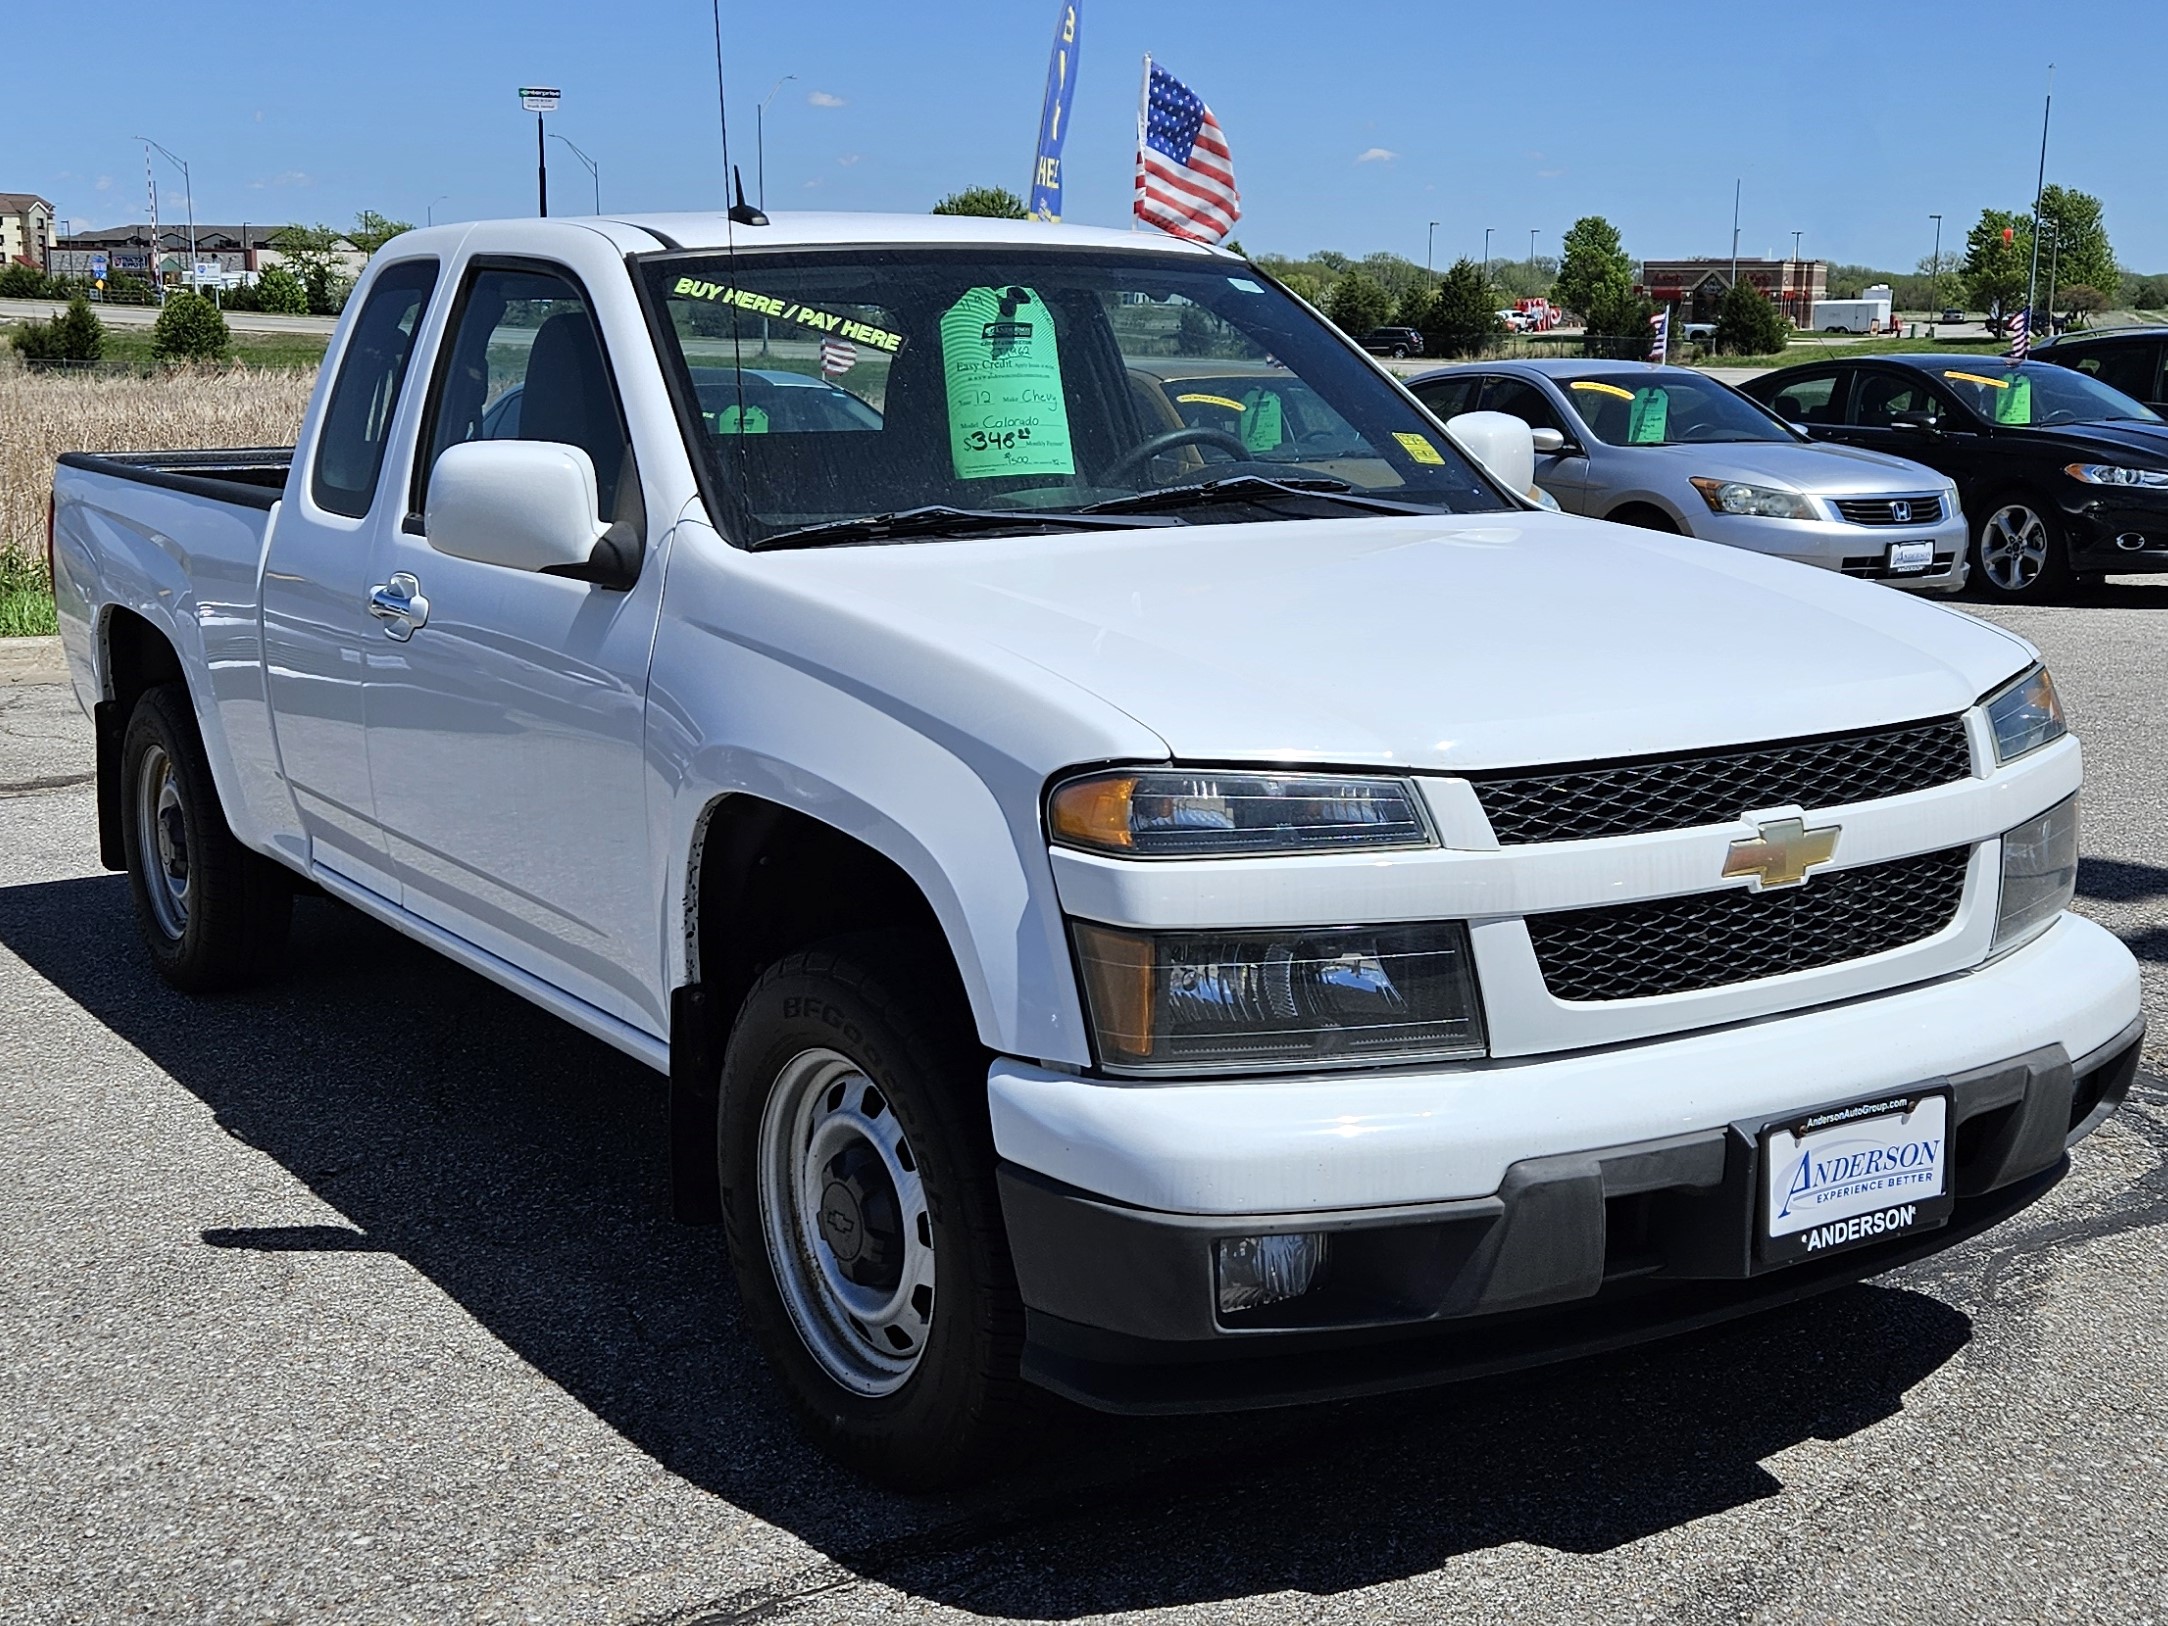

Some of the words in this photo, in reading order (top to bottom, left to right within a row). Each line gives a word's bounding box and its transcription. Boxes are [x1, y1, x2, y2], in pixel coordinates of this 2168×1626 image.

[674, 277, 724, 300] BUY
[722, 287, 786, 316] HERE
[783, 304, 799, 319] /
[797, 306, 842, 332] PAY
[839, 319, 902, 351] HERE
[957, 362, 978, 373] Easy
[982, 358, 1012, 370] Credit
[1022, 389, 1057, 411] Chevy
[983, 415, 1039, 428] Colorado
[1807, 1099, 1908, 1129] AndersonAutoGroup.com
[1777, 1140, 1940, 1219] ANDERSON
[1817, 1180, 1883, 1204] EXPERIENCE
[1888, 1172, 1933, 1187] BETTER
